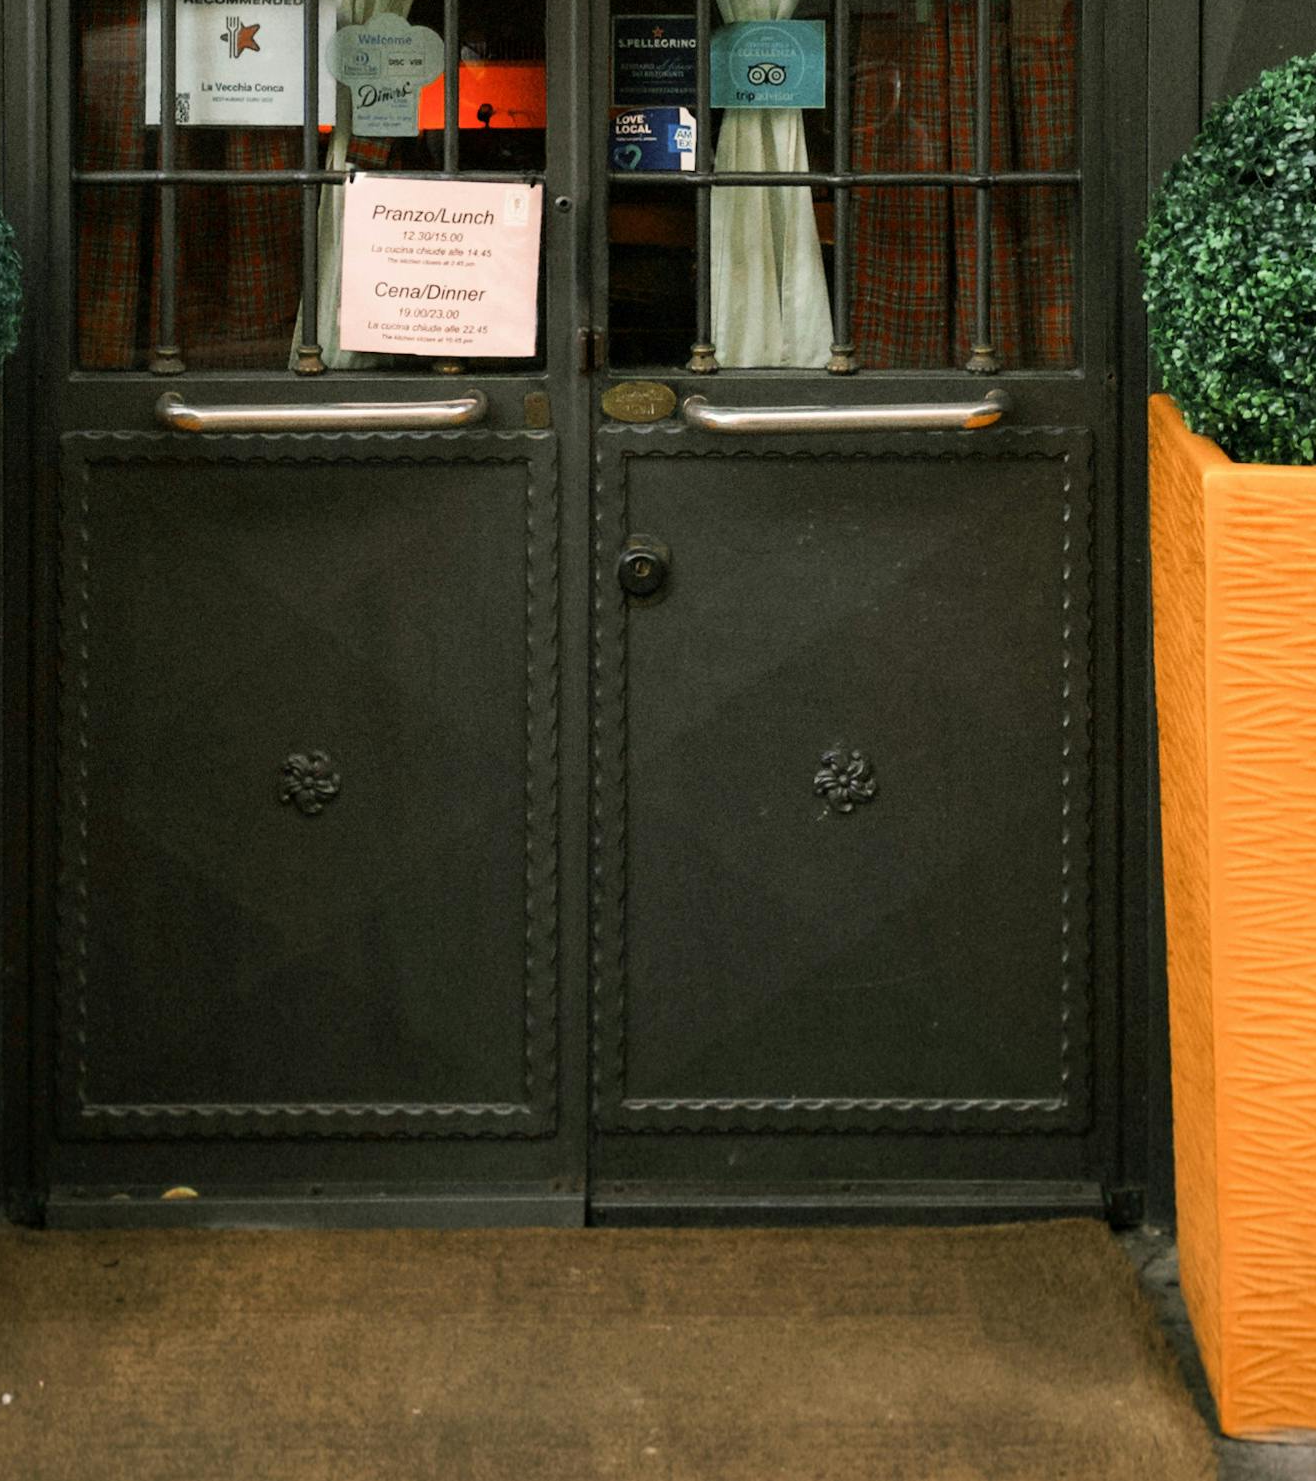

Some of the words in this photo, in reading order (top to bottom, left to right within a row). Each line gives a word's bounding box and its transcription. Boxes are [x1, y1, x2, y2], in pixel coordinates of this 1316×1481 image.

[359, 34, 413, 46] Welcome
[618, 38, 697, 49] S.PELLEGRINO
[388, 58, 423, 66] DISCVER
[201, 82, 213, 92] La
[215, 82, 252, 92] Vecchia
[254, 83, 284, 93] Conca
[736, 90, 795, 103] tripadvisor
[616, 114, 645, 125] LOVE
[615, 124, 652, 135] LOCAL
[372, 205, 495, 225] Pranzo/Lunch
[371, 245, 382, 254] La
[385, 246, 414, 255] cucina
[416, 247, 446, 257] chiude
[448, 248, 464, 257] alle
[374, 281, 486, 303] Cena/Dinner
[367, 321, 379, 330] La
[381, 322, 410, 332] cucina
[412, 323, 442, 333] chiude
[444, 324, 460, 333] alle
